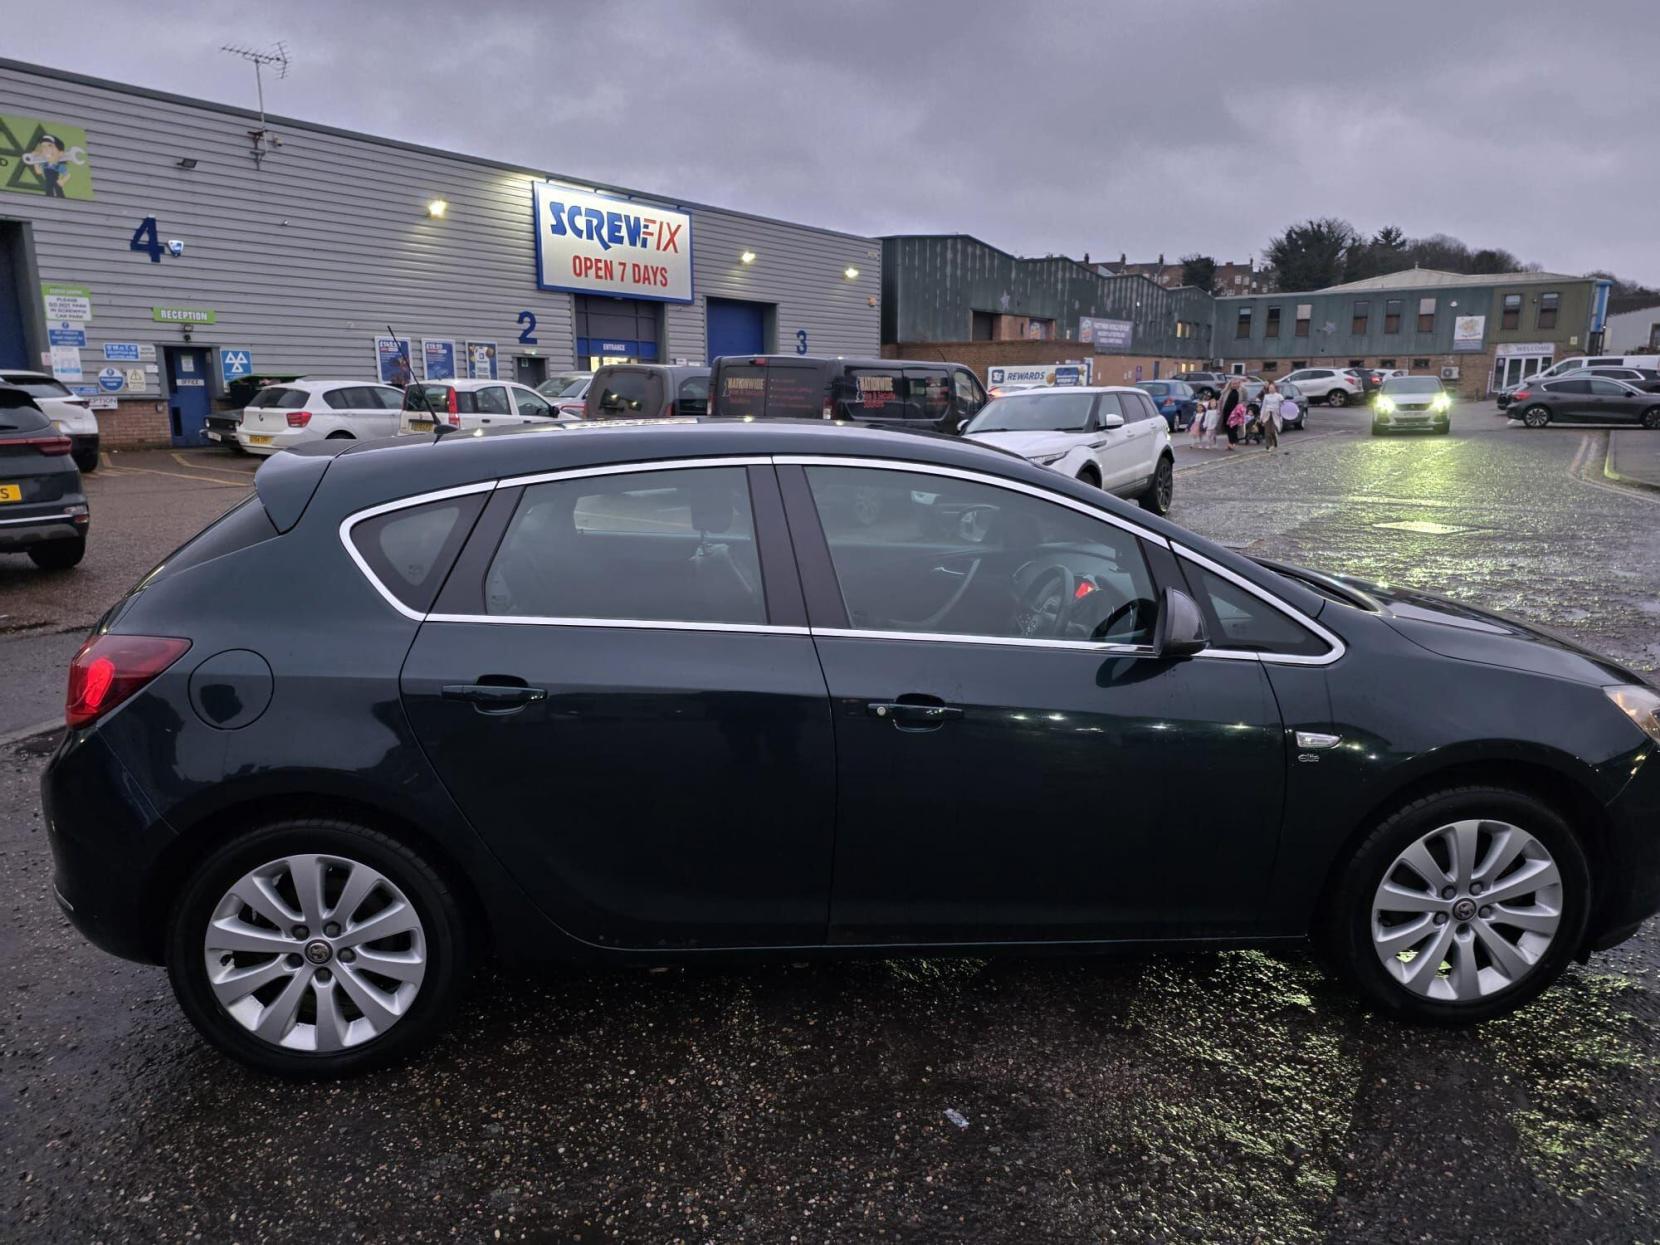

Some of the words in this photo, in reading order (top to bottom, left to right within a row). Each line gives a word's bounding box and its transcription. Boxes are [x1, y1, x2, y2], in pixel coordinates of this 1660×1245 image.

[130, 217, 165, 262] 4
[549, 201, 681, 253] SCREWFIX
[573, 255, 613, 281] OPEN
[618, 262, 627, 282] 7
[632, 263, 668, 288] DAYS
[161, 309, 208, 321] RECEPTION
[517, 311, 538, 345] 2
[796, 330, 807, 355] 3
[1007, 371, 1046, 381] REWARDS
